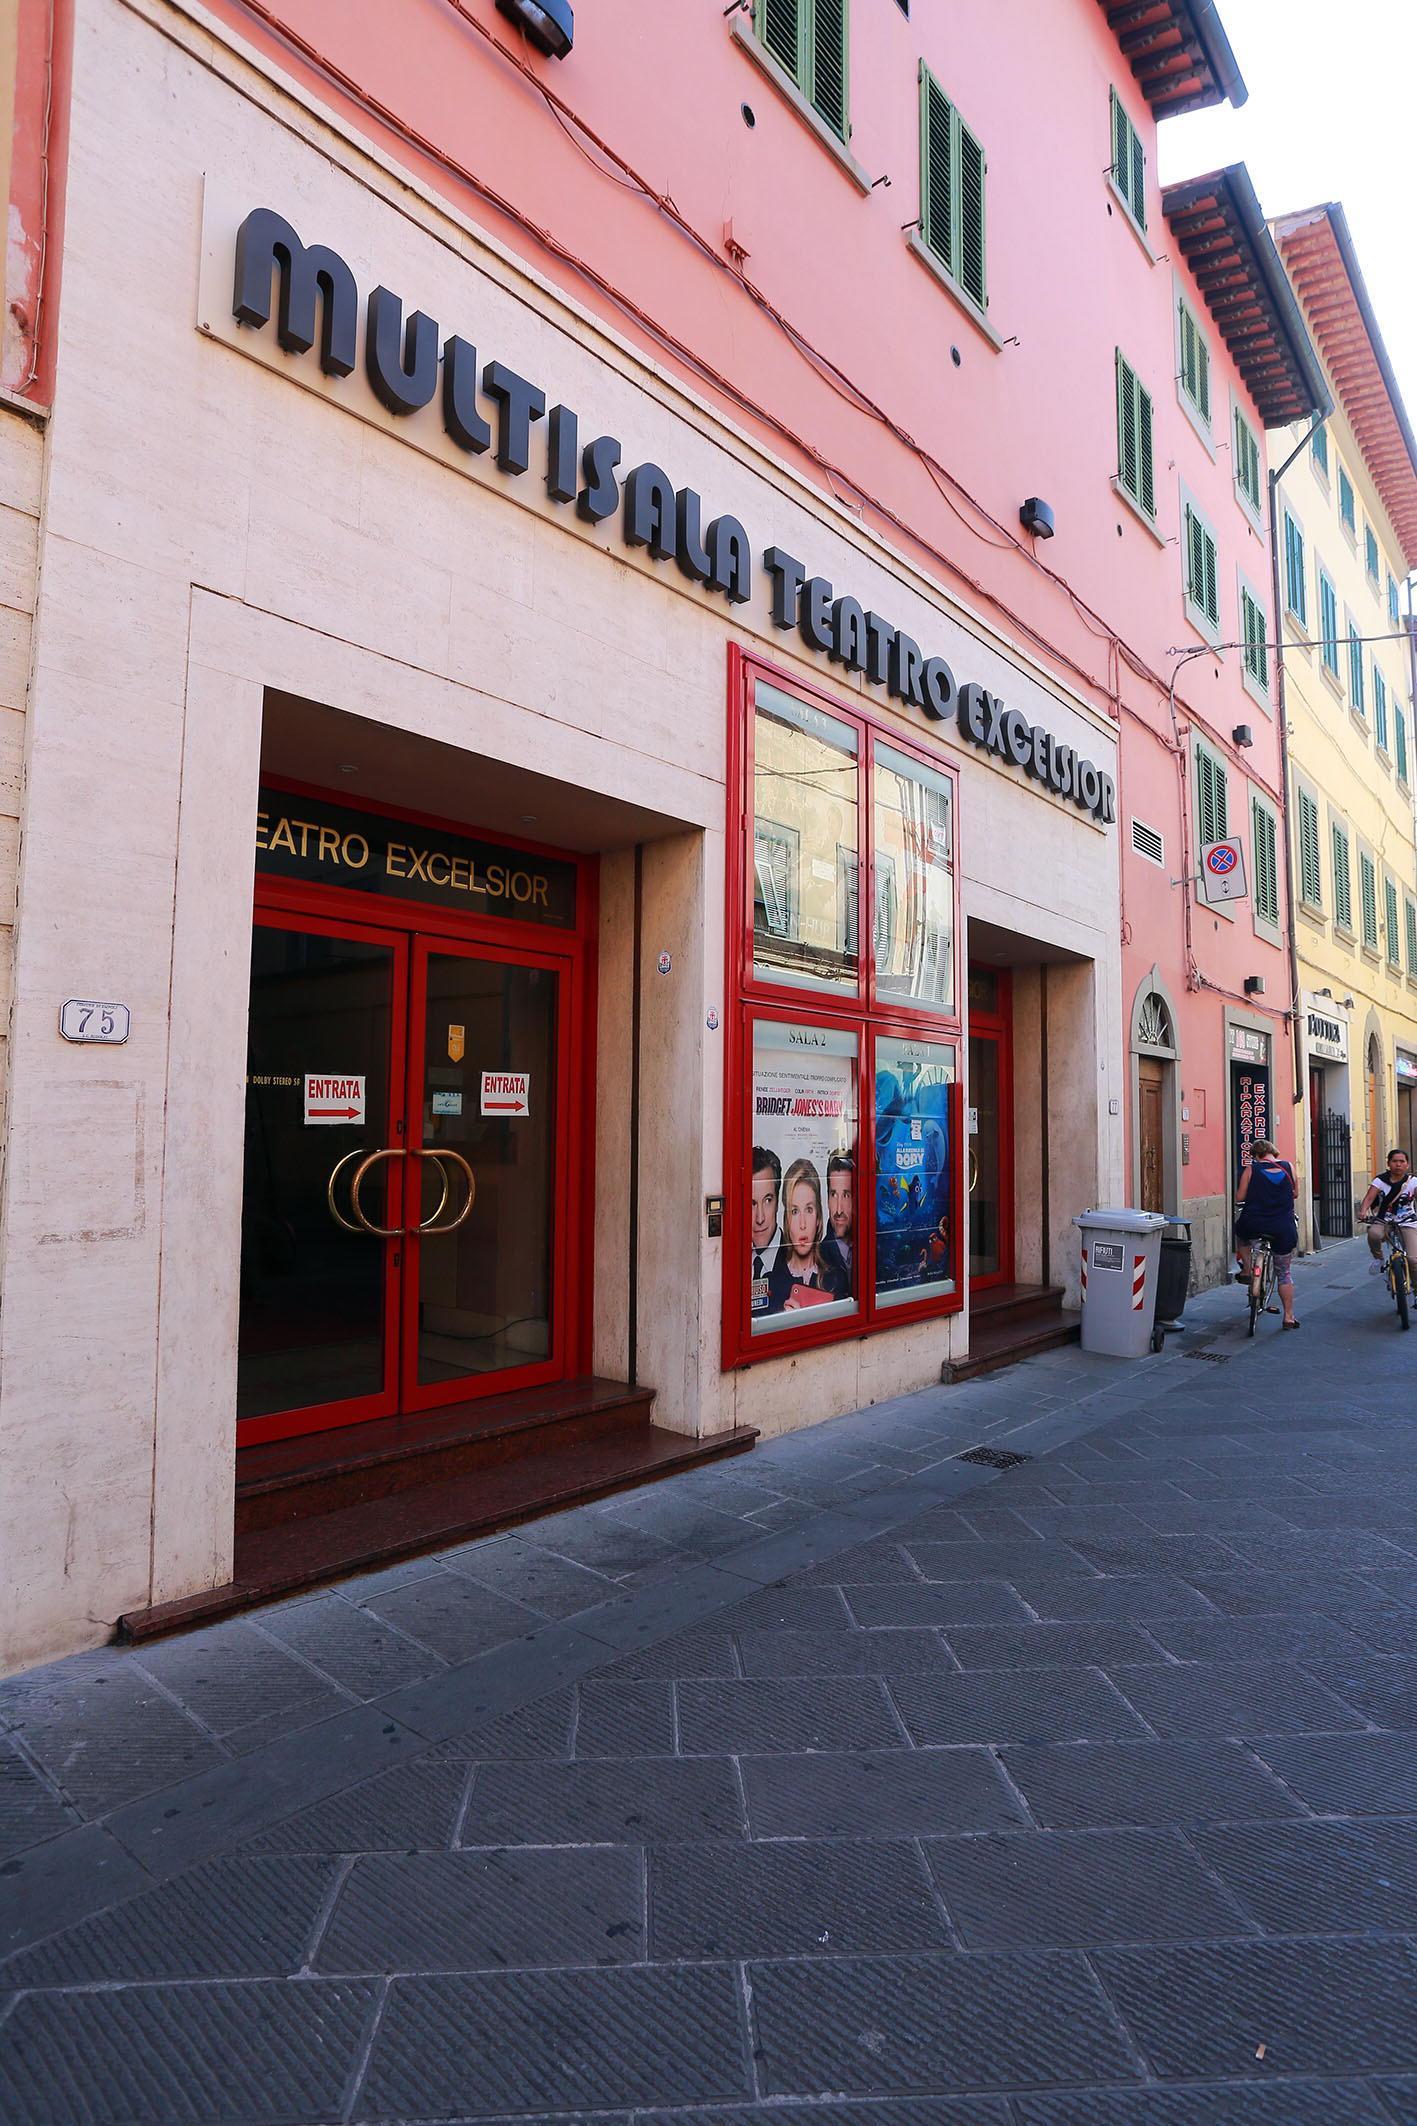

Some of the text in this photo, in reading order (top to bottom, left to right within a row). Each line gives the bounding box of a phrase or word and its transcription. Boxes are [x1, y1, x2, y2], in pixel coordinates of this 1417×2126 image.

[232, 208, 1116, 824] MULTISALA TEATRO EXCELSIOR
[385, 841, 549, 907] EXCELSIOR
[78, 1008, 115, 1034] 75
[788, 1029, 826, 1047] SALA 2
[252, 1076, 271, 1085] DOLBY
[272, 1077, 292, 1086] STEREO
[308, 1079, 361, 1099] ENTRATA
[484, 1076, 526, 1094] ENTRATA
[756, 1096, 793, 1117] BRIDGET
[790, 1098, 824, 1118] JONES'S
[1240, 1076, 1253, 1168] RIPARAZIONE
[896, 1152, 925, 1166] DORY
